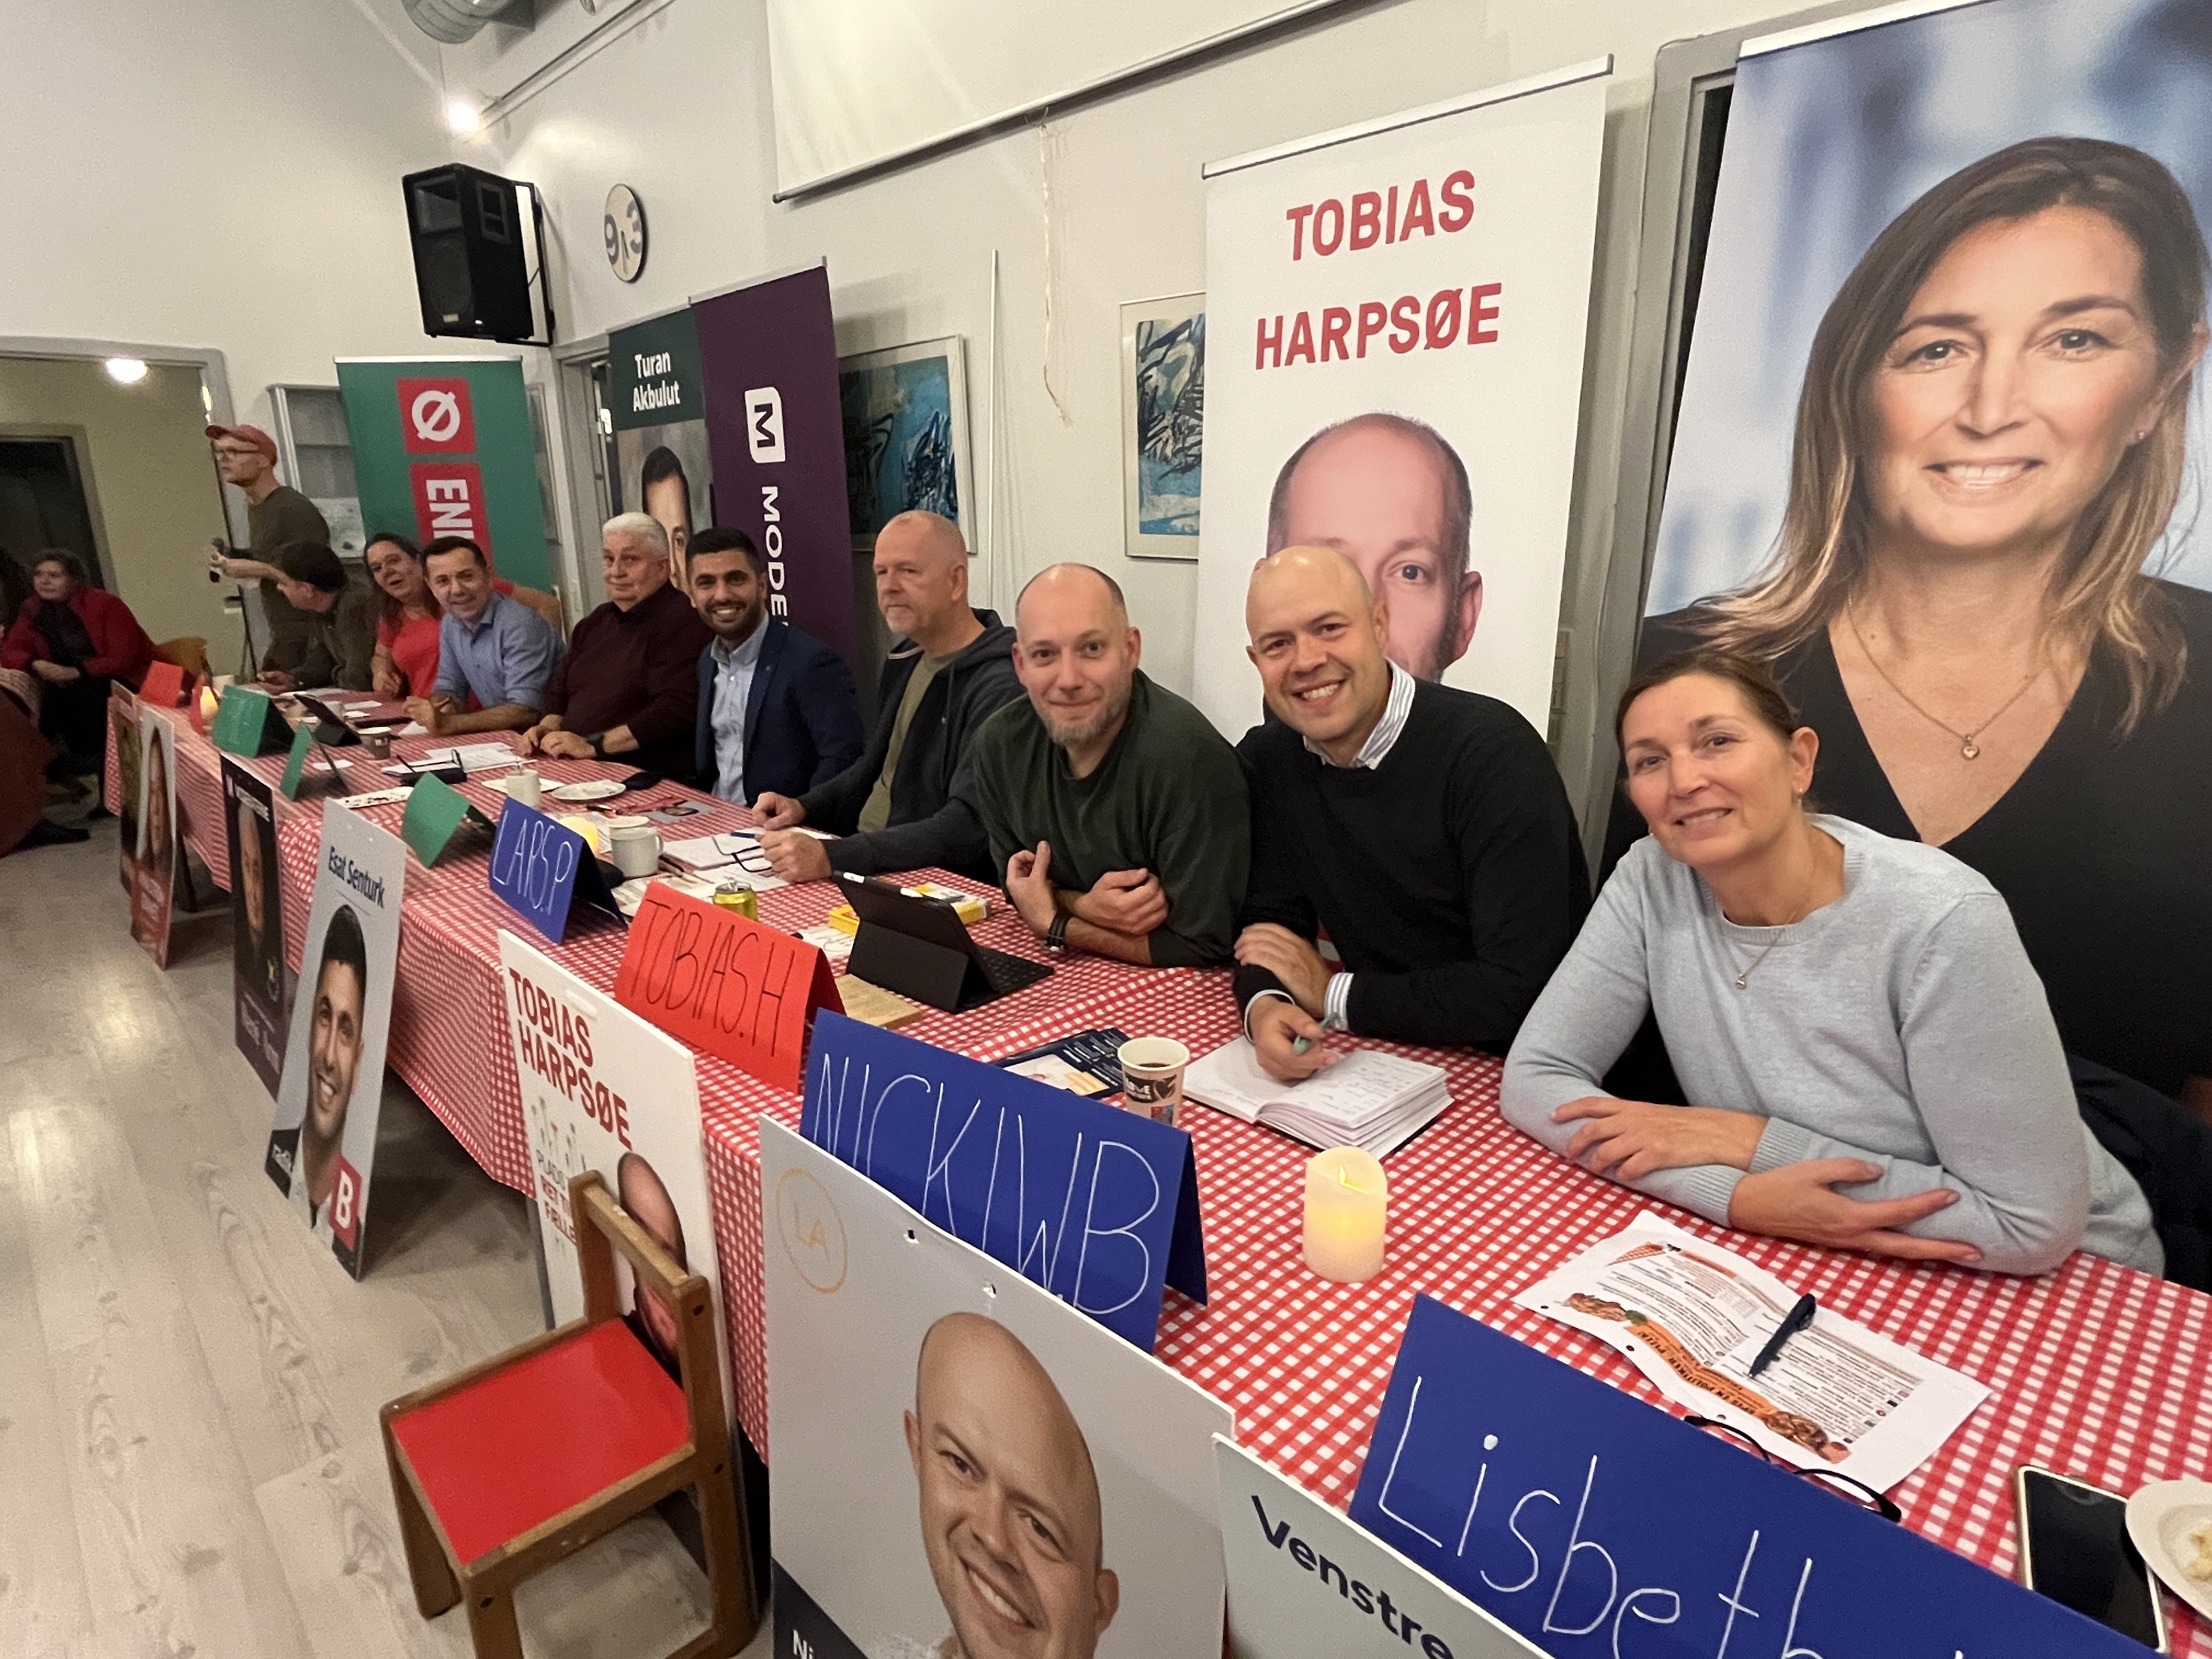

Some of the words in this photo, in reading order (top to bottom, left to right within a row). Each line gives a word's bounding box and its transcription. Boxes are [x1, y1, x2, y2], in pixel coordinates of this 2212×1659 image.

[604, 213, 619, 265] 9
[1286, 170, 1476, 261] TOBIAS
[1255, 282, 1502, 370] HARPSØE
[634, 352, 671, 379] Turan
[411, 390, 460, 442] Ø
[633, 380, 680, 412] Akbulut
[754, 403, 775, 449] M
[761, 486, 788, 627] MODE
[329, 845, 347, 881] Esat
[509, 967, 594, 1068] TOBIAS
[518, 1019, 633, 1151] HARPSØE
[335, 1169, 354, 1229] B
[1251, 1495, 1455, 1659] Venstre
